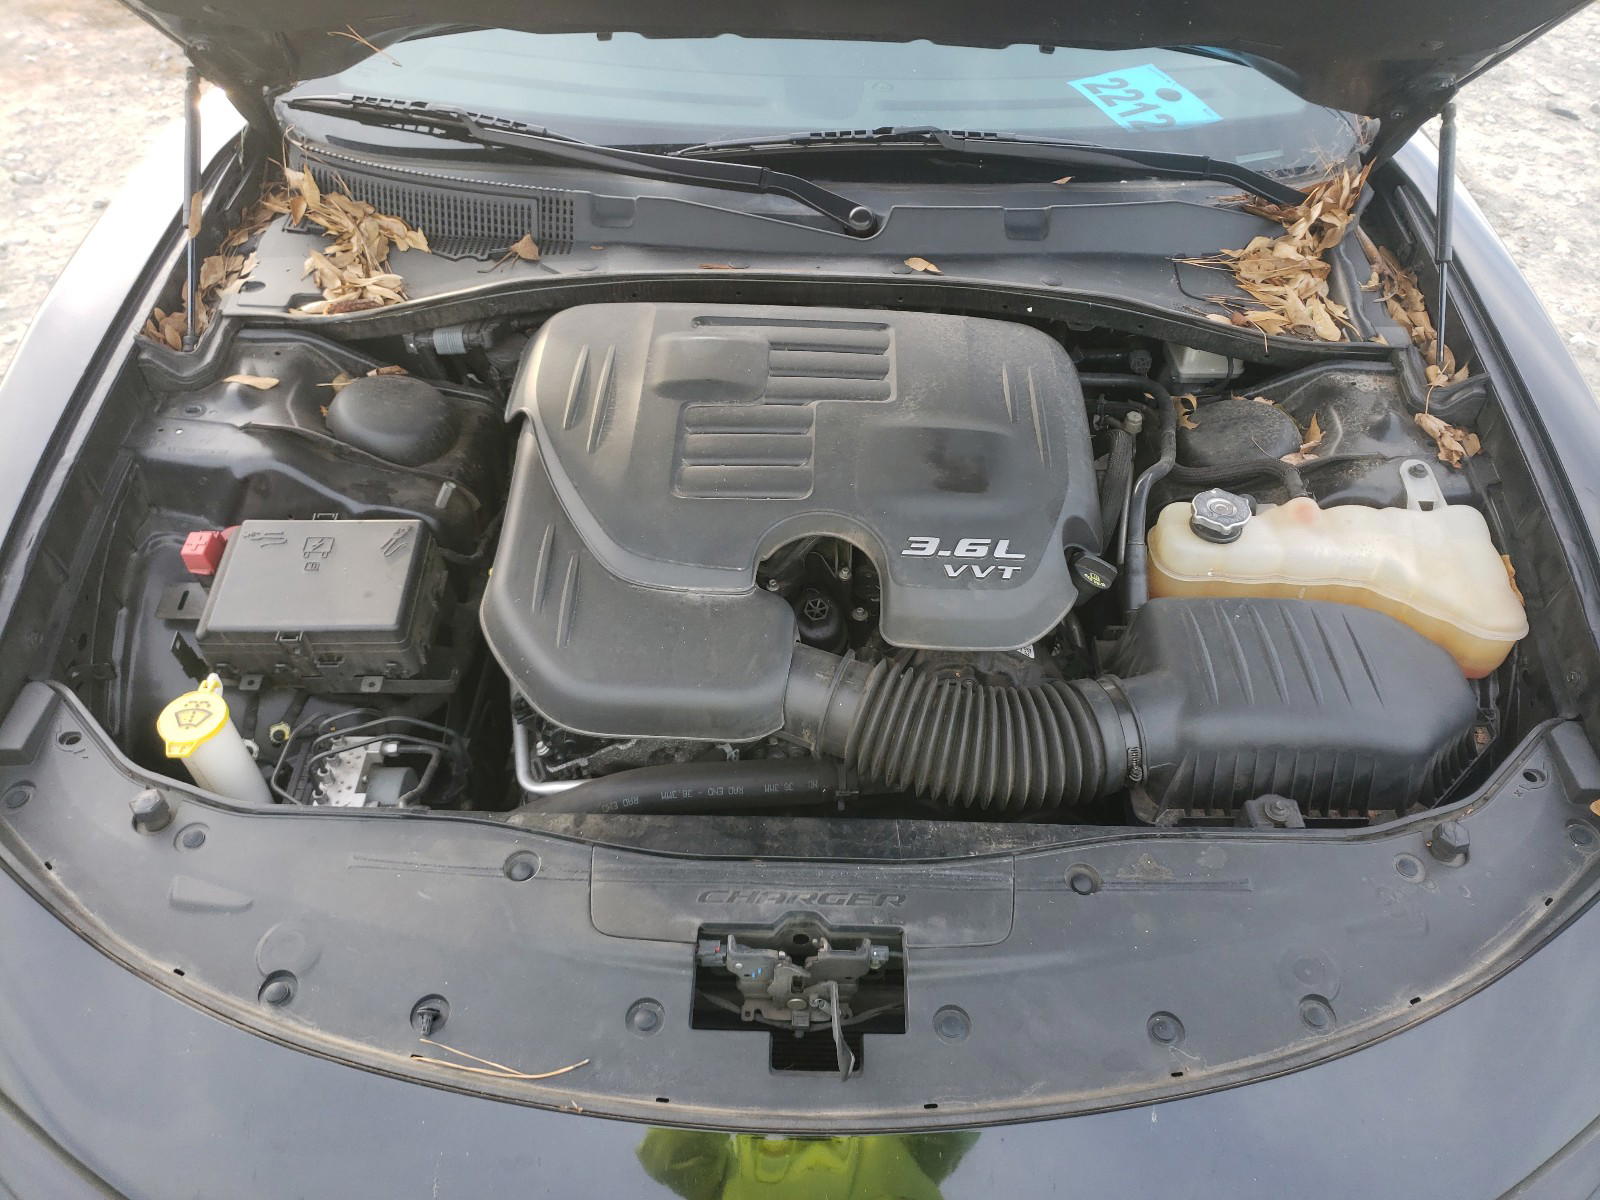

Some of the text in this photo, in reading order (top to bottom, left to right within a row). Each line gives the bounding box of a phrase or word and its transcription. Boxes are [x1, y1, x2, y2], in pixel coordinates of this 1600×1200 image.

[1082, 77, 1176, 133] 2212
[901, 536, 1026, 560] 3.6L
[944, 564, 1022, 580] VVT
[697, 889, 906, 907] CHARGER
